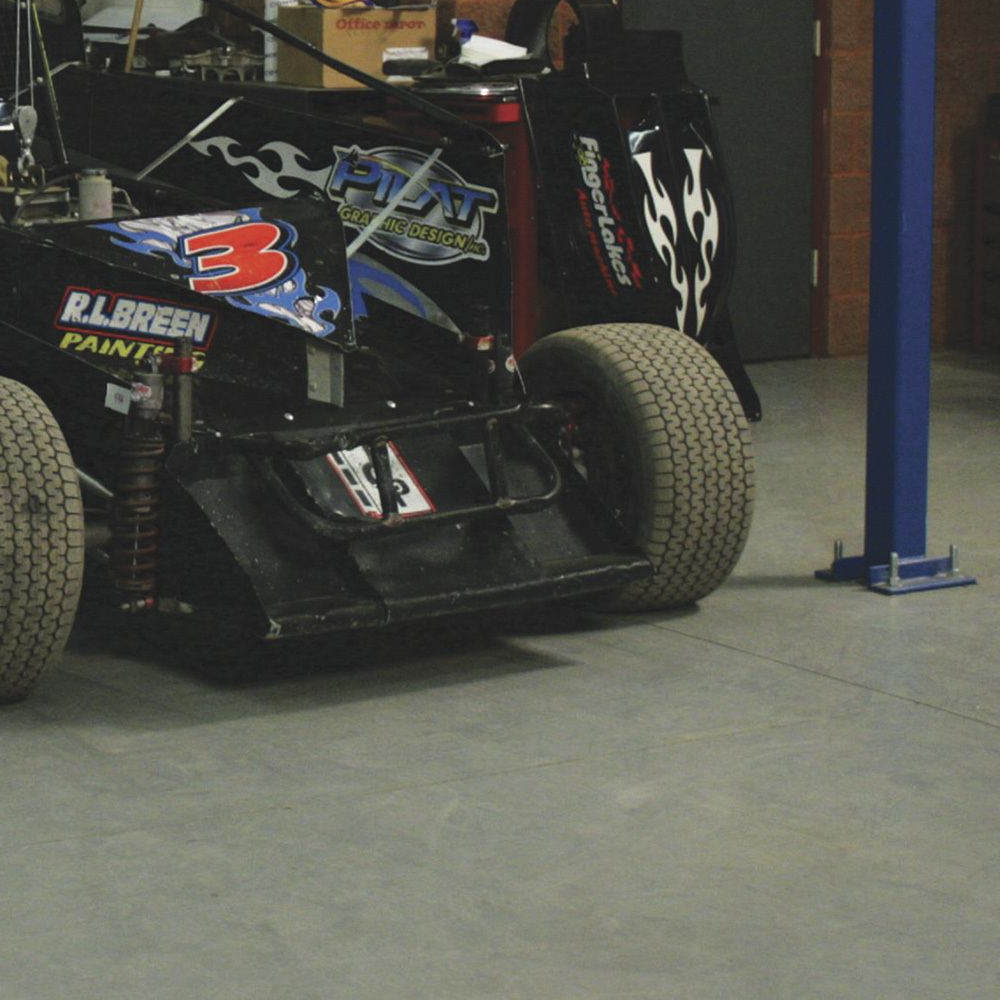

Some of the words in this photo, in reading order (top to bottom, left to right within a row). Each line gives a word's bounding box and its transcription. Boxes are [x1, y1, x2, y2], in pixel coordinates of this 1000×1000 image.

[335, 17, 381, 30] Office
[339, 207, 408, 235] GRAHIC
[408, 223, 467, 249] DESIGN
[184, 222, 290, 294] 3
[60, 291, 210, 343] R.L.BREEN
